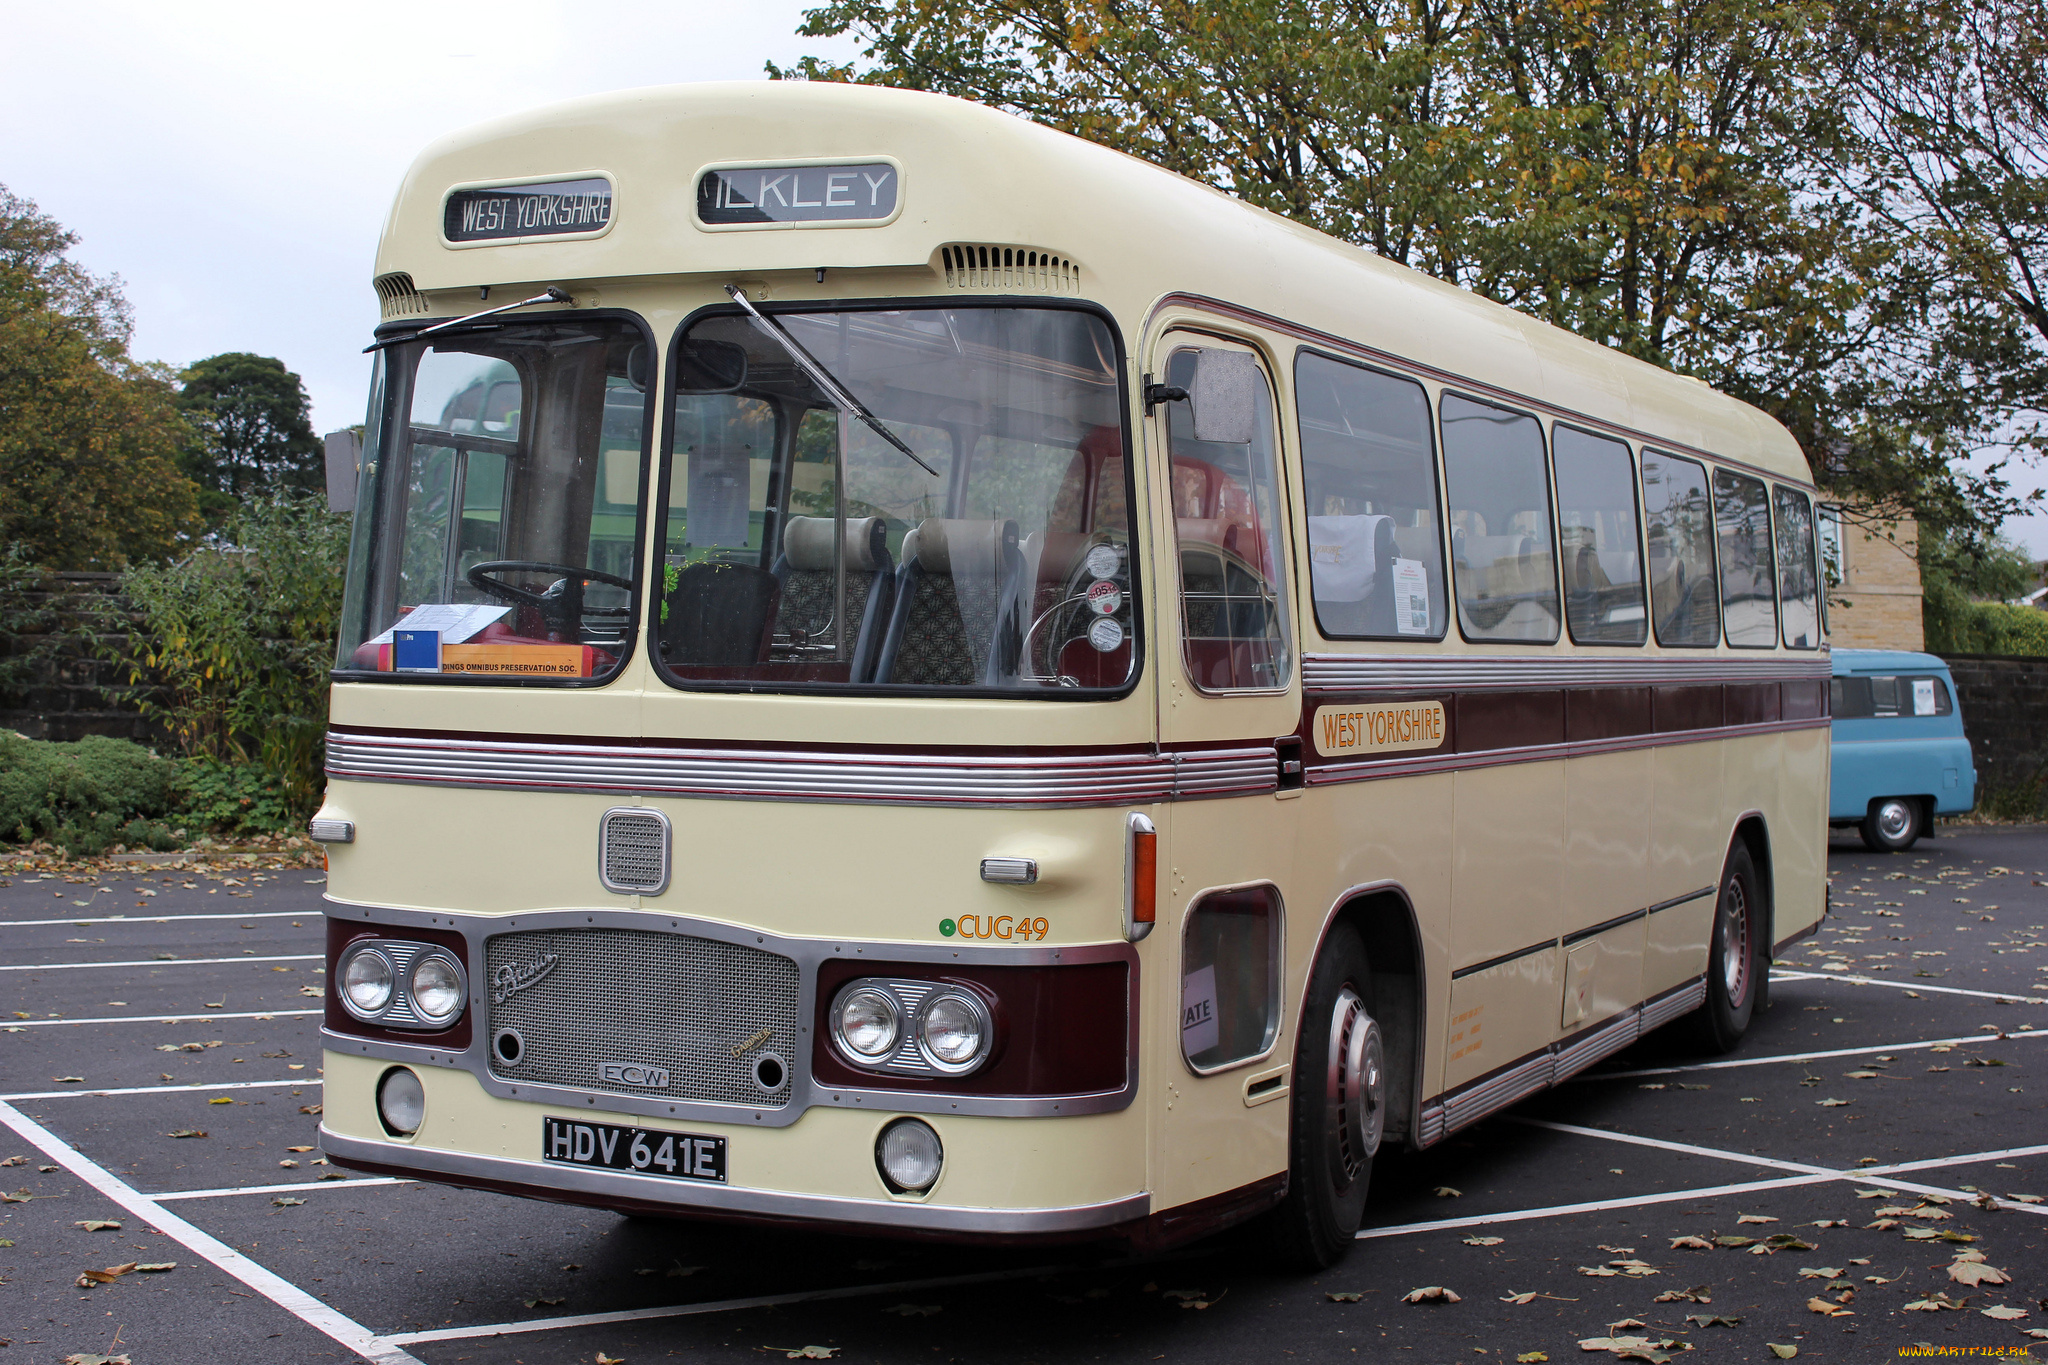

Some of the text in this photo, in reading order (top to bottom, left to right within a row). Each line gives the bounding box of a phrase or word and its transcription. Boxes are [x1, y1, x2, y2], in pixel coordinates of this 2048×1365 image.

[716, 172, 891, 208] ILKLEY
[463, 191, 612, 232] WEST YORKSHIRE
[1096, 585, 1108, 596] 05
[500, 664, 556, 672] PRESERVATION
[1323, 707, 1441, 748] WEST YORKSHIRE
[957, 914, 1049, 941] CUG 49
[731, 1028, 771, 1058] GARDNER
[604, 1065, 663, 1086] ECW
[552, 1122, 717, 1177] HDV 641E
